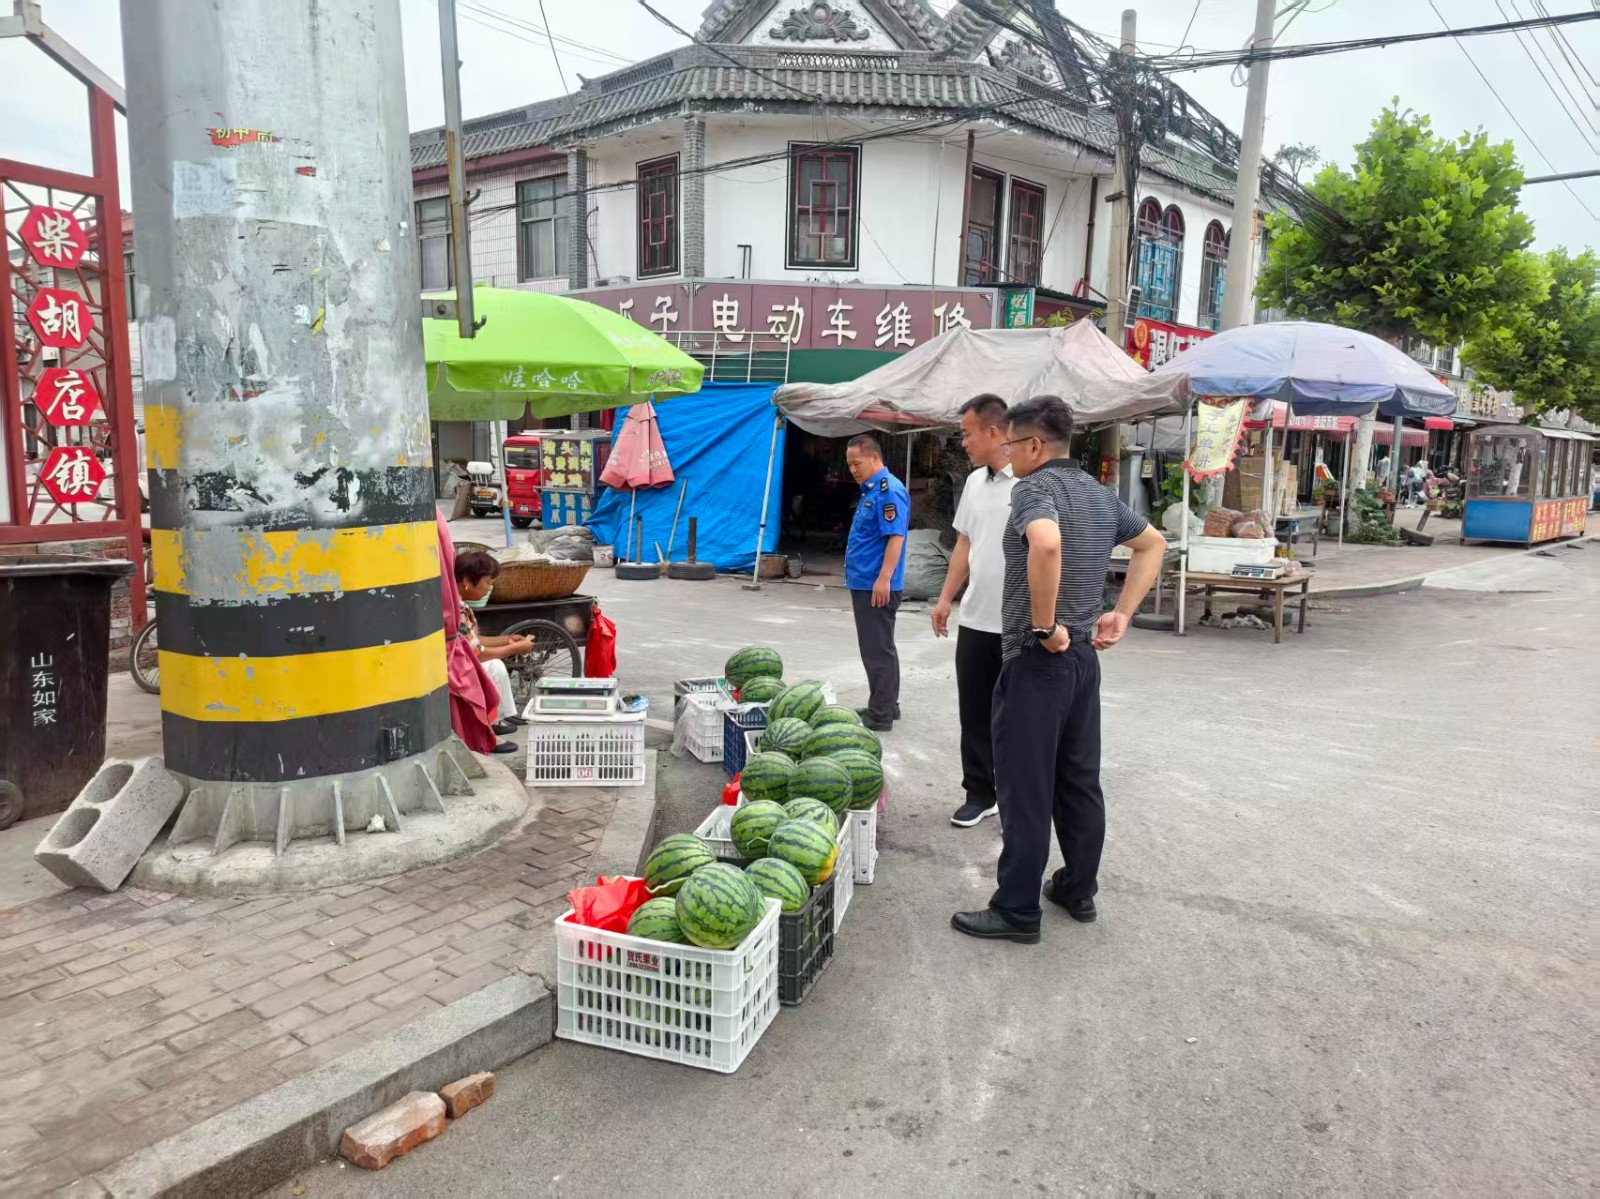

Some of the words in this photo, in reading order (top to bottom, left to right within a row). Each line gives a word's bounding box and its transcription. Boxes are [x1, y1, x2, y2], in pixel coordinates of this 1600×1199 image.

[33, 211, 98, 497] 柴胡店镇
[499, 364, 584, 390] 娃哈哈
[30, 651, 57, 727] 山东如家
[577, 768, 593, 779] 06
